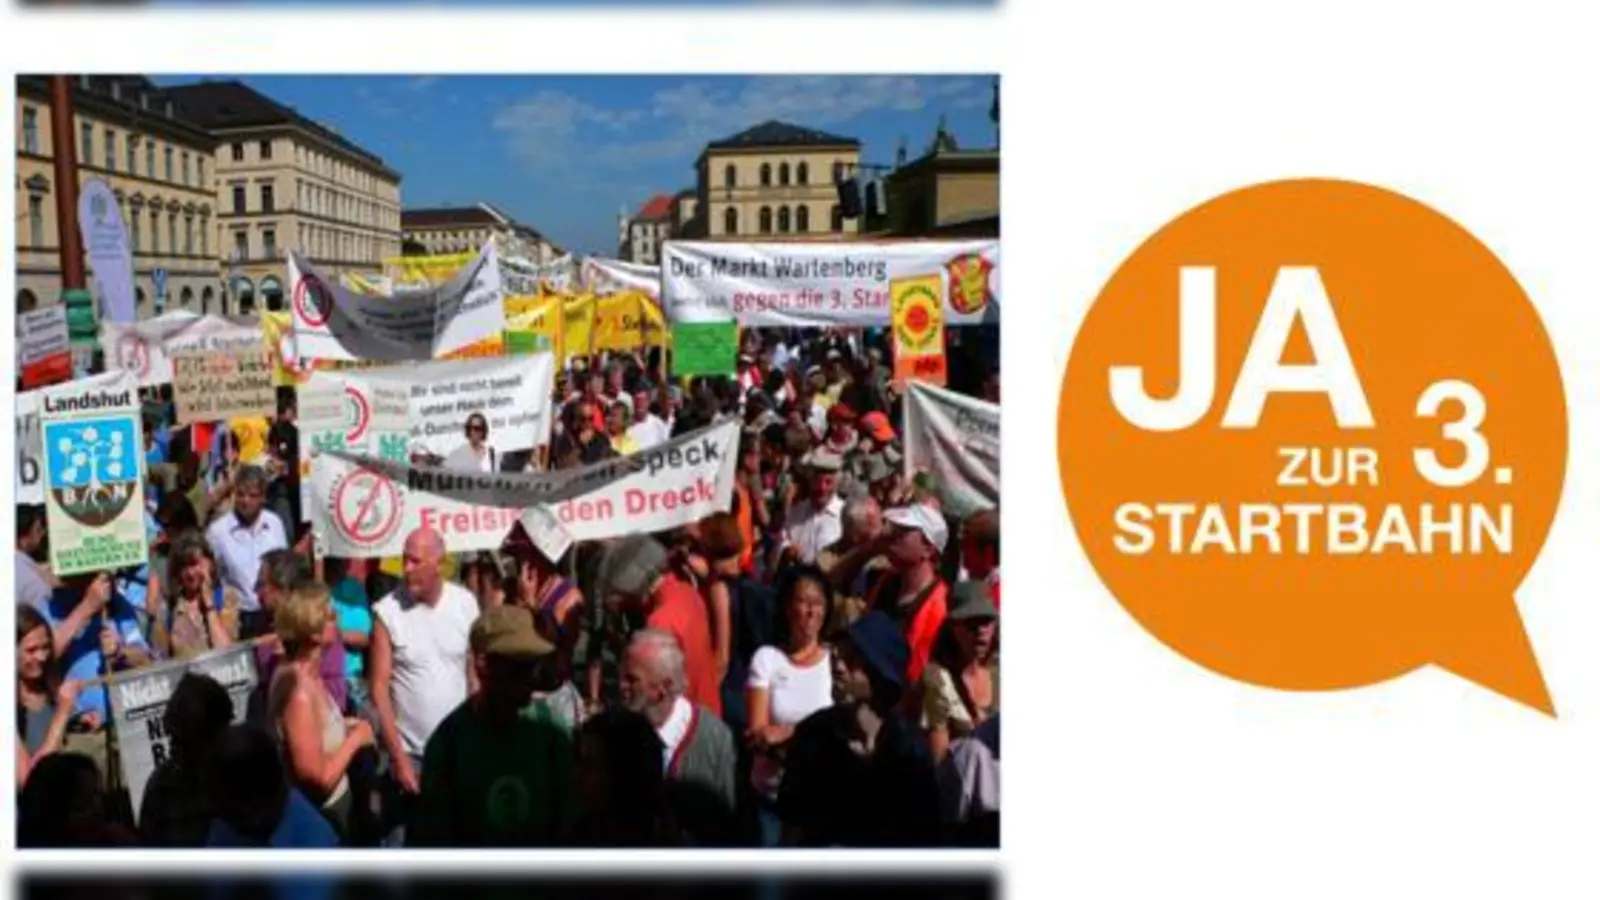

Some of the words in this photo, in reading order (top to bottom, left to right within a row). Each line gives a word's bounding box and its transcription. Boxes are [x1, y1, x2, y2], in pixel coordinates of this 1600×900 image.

[671, 255, 702, 278] Der
[711, 255, 767, 278] Markt
[774, 256, 886, 282] Wartenberg
[733, 290, 790, 312] gegen
[796, 288, 823, 309] die
[853, 288, 890, 310] Star
[44, 391, 131, 412] Landshut
[558, 497, 613, 523] den
